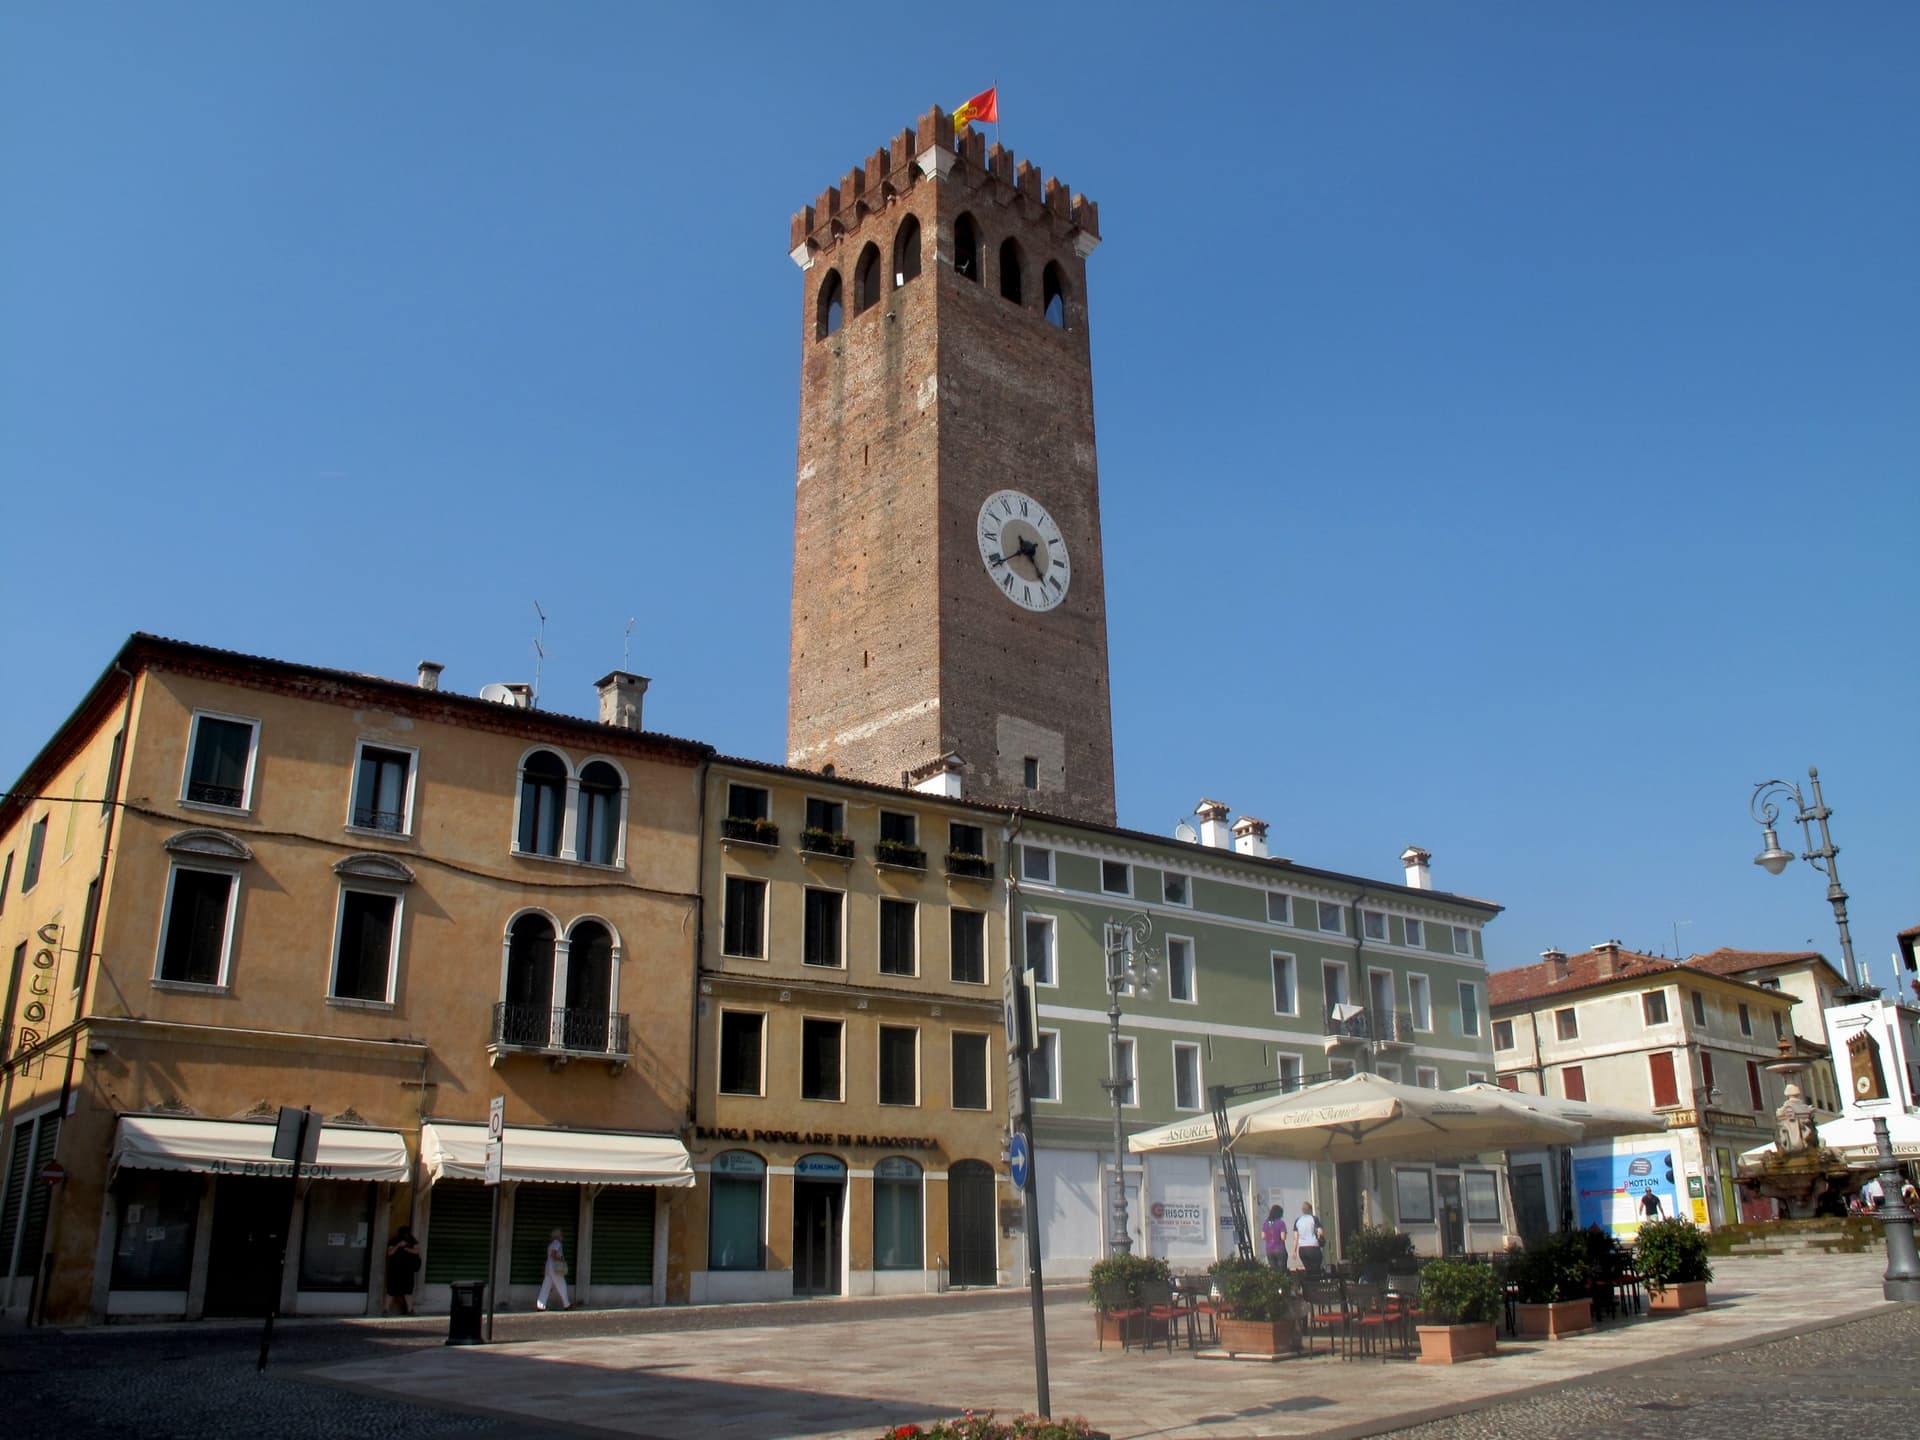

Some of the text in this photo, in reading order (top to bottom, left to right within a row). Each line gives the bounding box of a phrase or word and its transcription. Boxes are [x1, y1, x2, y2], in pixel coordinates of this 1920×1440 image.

[19, 923, 58, 1077] COLORI
[696, 1126, 749, 1140] BANCA
[753, 1130, 832, 1145] POPOLARE
[209, 1160, 332, 1177] AL BOTTEGON
